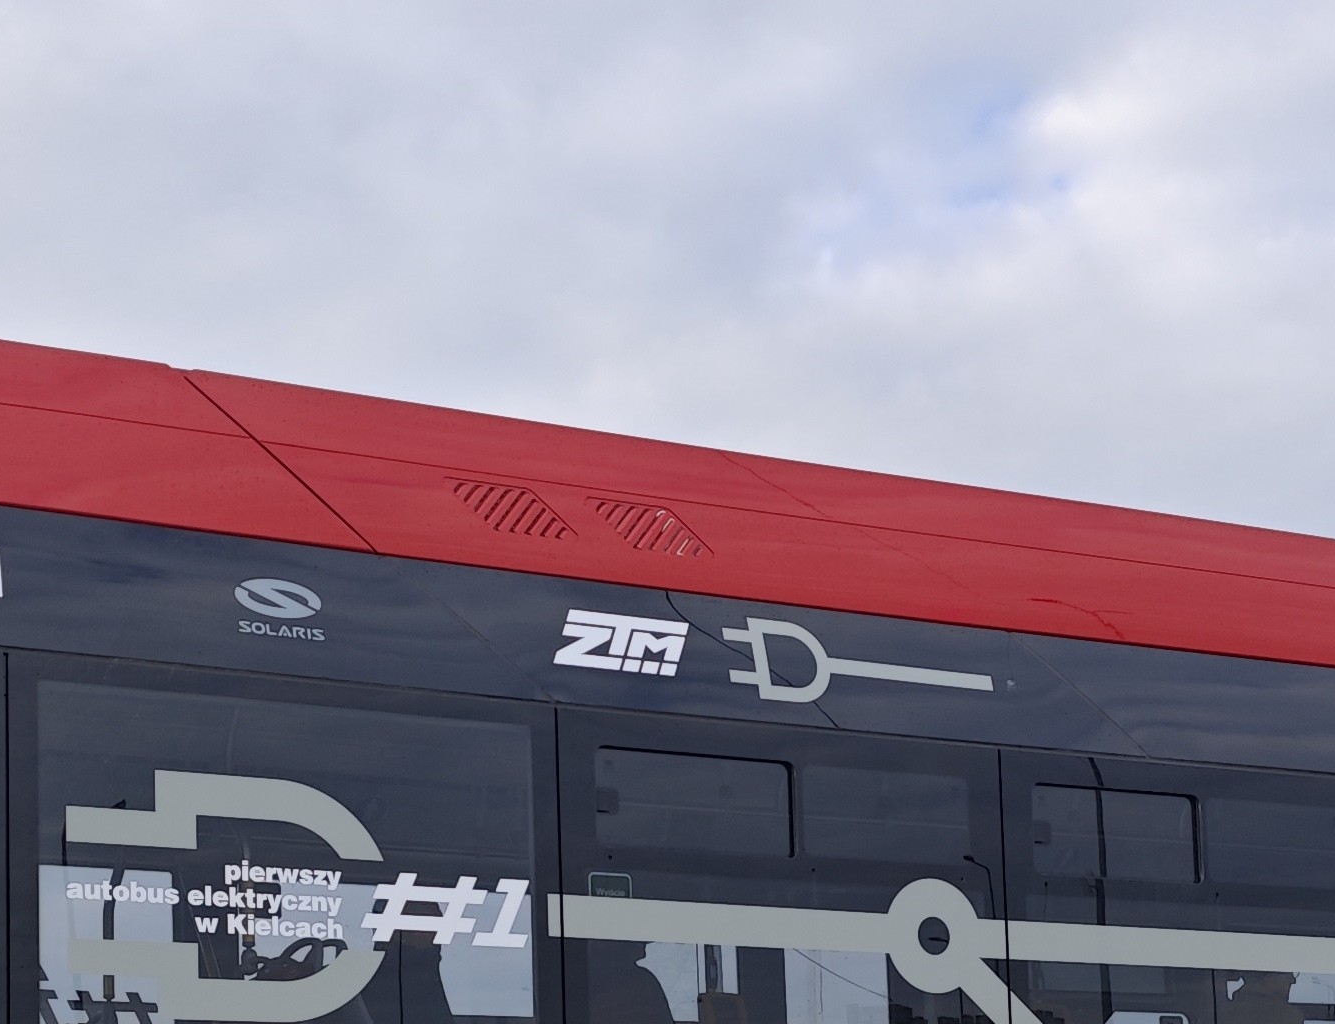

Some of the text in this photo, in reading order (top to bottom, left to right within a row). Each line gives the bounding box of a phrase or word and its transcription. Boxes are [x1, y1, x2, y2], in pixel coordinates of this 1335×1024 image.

[238, 620, 326, 641] SOLARIS
[553, 609, 690, 677] ZTM
[225, 860, 342, 889] pierwszy
[66, 880, 343, 917] autobus elektryczny
[361, 872, 530, 948] #1
[195, 913, 344, 938] w Kielcach
